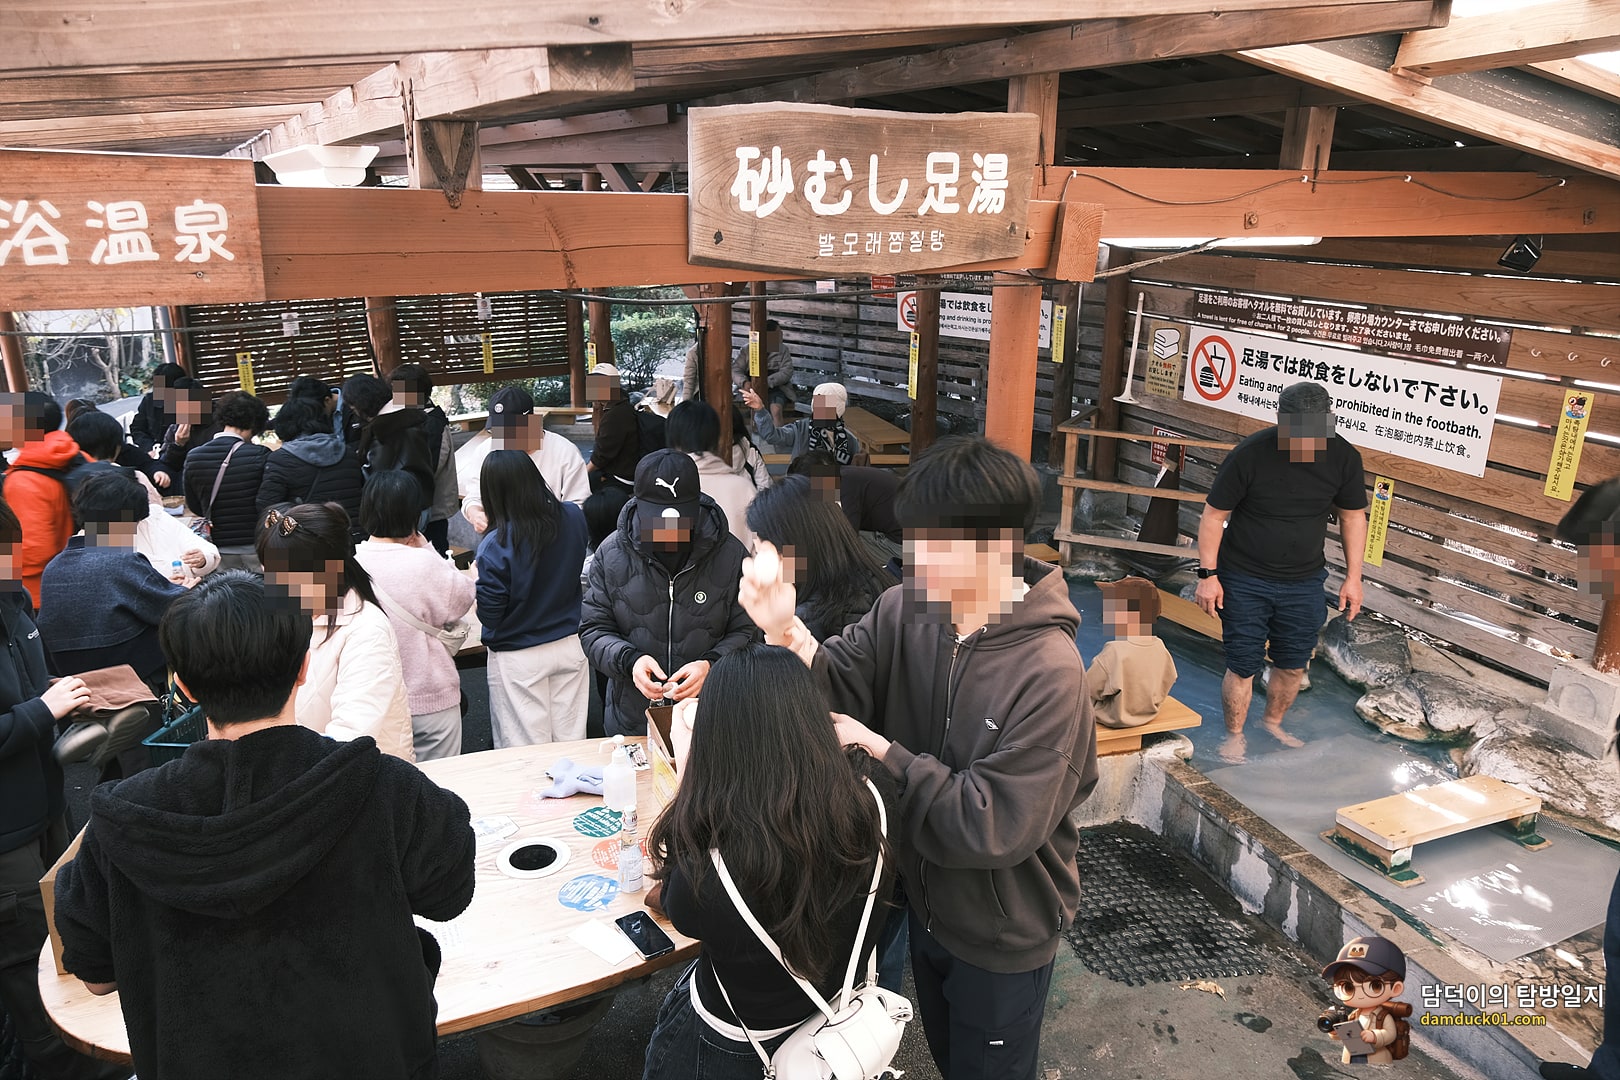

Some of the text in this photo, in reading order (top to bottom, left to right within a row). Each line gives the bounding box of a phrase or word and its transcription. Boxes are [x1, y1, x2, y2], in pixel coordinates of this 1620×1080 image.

[731, 146, 1008, 218] 砂むし足湯
[818, 229, 945, 257] 발모래찜질탕
[956, 315, 977, 324] drinking
[1239, 374, 1265, 393] Eating
[1266, 383, 1284, 394] and
[1336, 396, 1390, 418] prohibited
[1391, 407, 1402, 421] in
[1404, 410, 1423, 426] the
[1426, 415, 1482, 440] footbath.
[1241, 348, 1489, 415] 足湯では飲食をしないで下さい。
